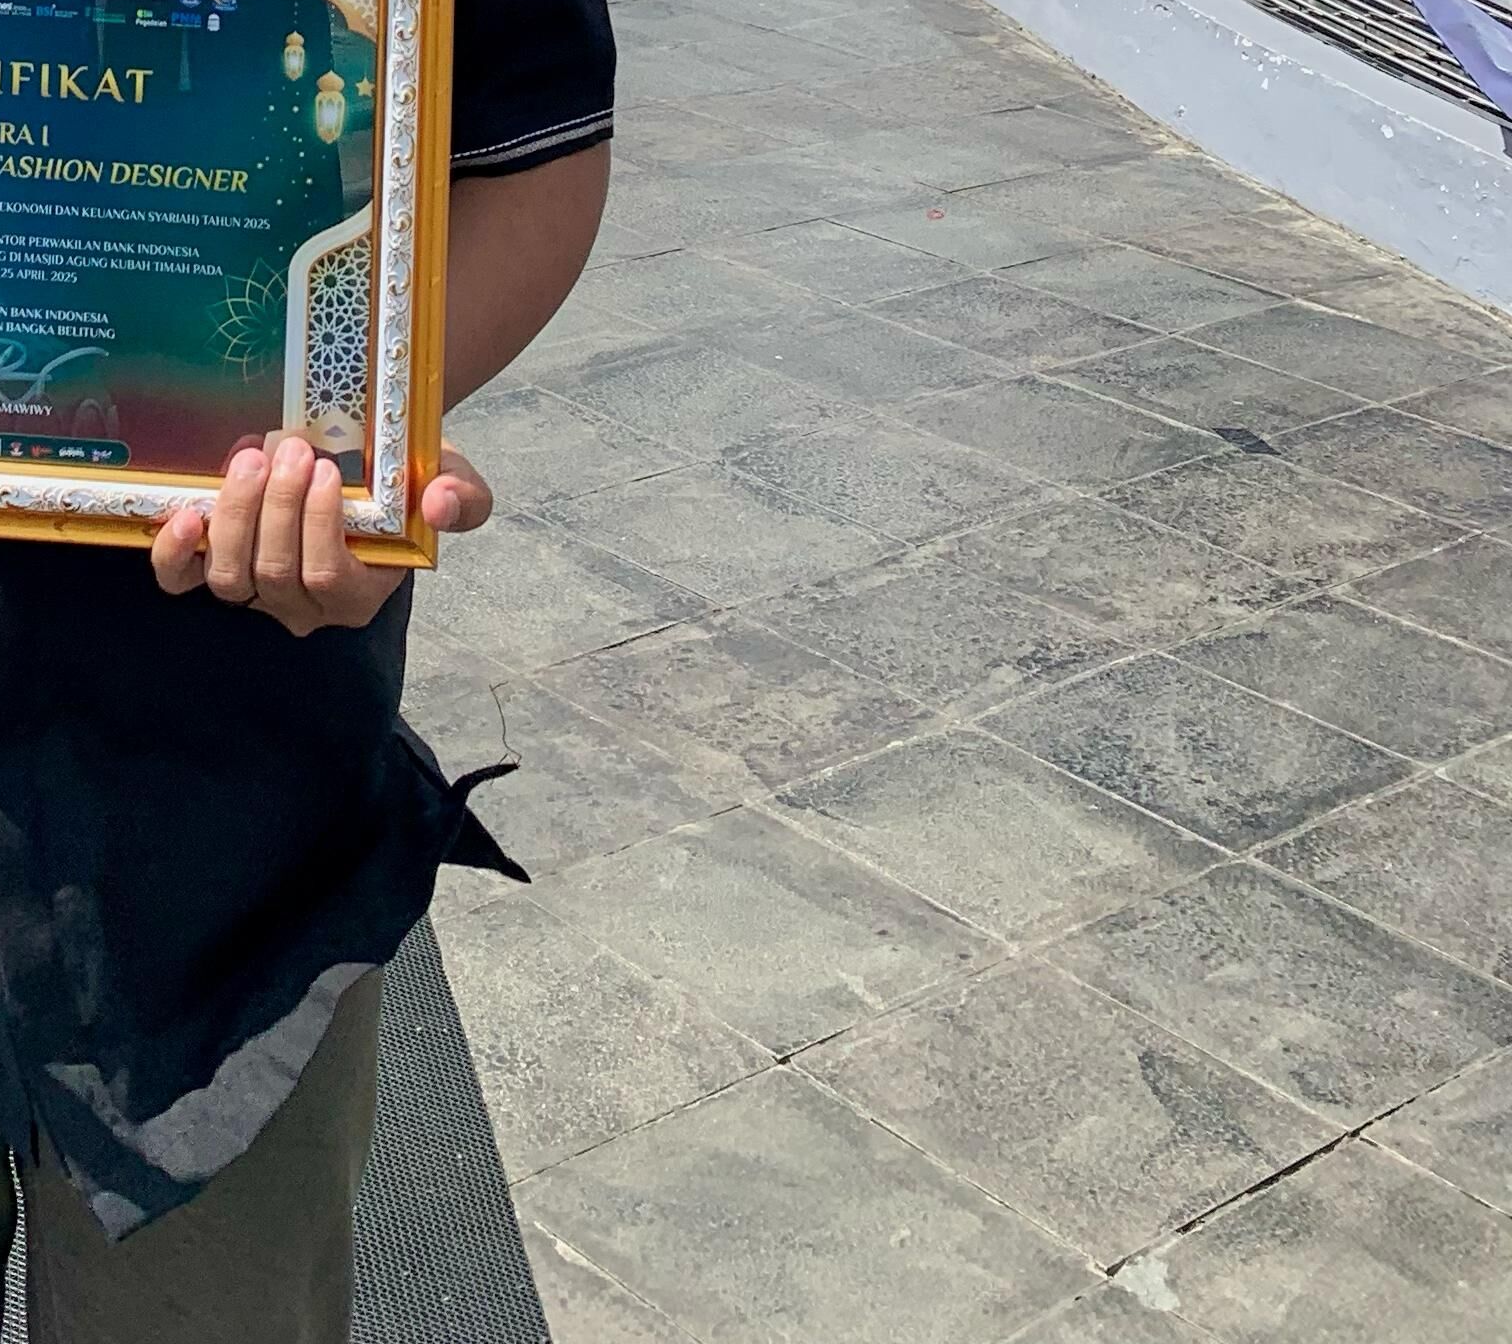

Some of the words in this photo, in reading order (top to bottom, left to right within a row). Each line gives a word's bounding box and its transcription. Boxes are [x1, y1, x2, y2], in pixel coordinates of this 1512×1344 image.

[41, 124, 50, 147] I
[110, 161, 249, 194] DESIGNER
[0, 201, 52, 215] EKONOMI
[55, 205, 80, 217] DAN
[81, 206, 146, 222] KEUANGAN
[148, 211, 200, 226] SYARIAH)
[202, 214, 241, 228] TAHUN
[243, 216, 271, 230] 2025
[28, 236, 101, 252] PERWAKILAN
[103, 241, 135, 254] BANK
[137, 243, 200, 258] INDONESIA
[9, 251, 22, 262] DI
[23, 252, 64, 266] MASJID
[65, 255, 108, 269] AGUNG
[110, 258, 151, 272] KUBAH
[154, 261, 190, 274] TIMAH
[192, 263, 223, 276] PADA
[0, 267, 14, 279] 25
[16, 269, 48, 281] APRIL
[50, 271, 78, 283] 2025
[10, 307, 43, 320] BANK
[45, 310, 109, 324] INDONESIA
[6, 321, 55, 335] BANGKA
[57, 325, 116, 340] BELITUNG
